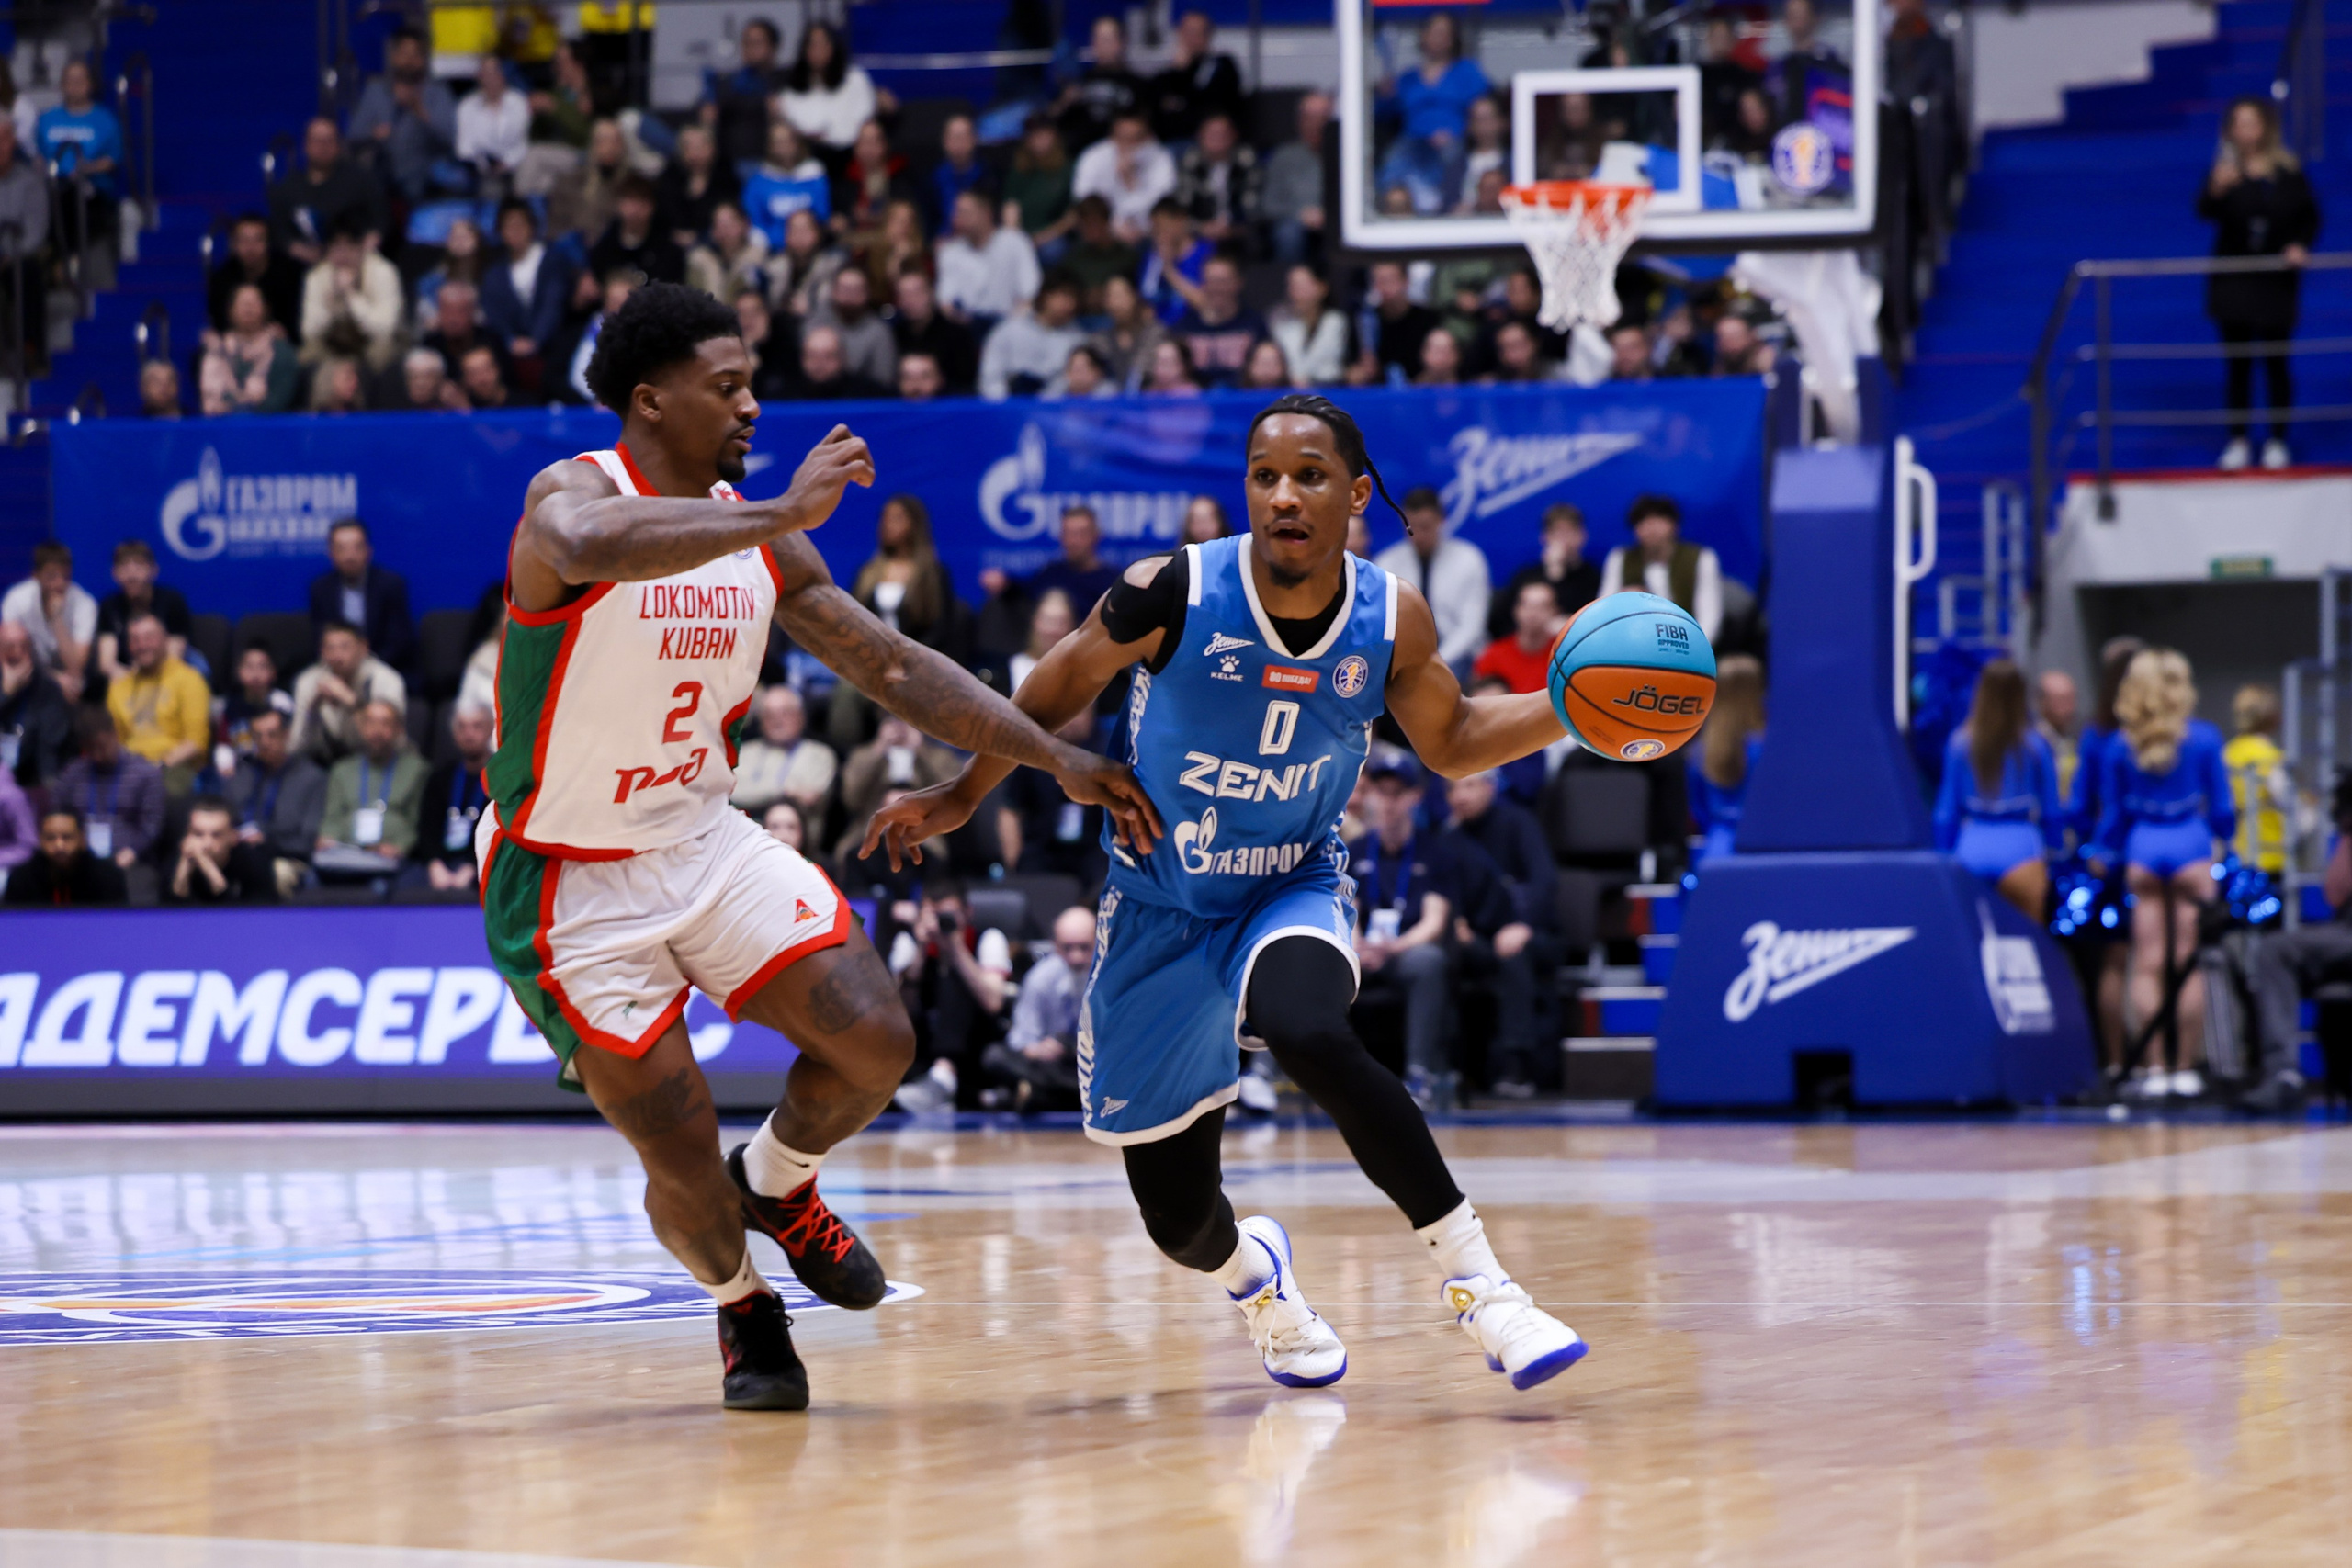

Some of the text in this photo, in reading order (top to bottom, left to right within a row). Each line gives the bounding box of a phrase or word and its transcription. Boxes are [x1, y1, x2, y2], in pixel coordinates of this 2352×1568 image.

[640, 584, 755, 620] LOKOMOTIV
[658, 627, 737, 660] KUBAN
[1656, 624, 1689, 641] FIBA
[1210, 671, 1244, 682] KELME
[662, 681, 704, 745] 2
[1611, 684, 1706, 715] JÖGEL
[1258, 700, 1300, 755] 0
[1179, 750, 1331, 802] ZENIT
